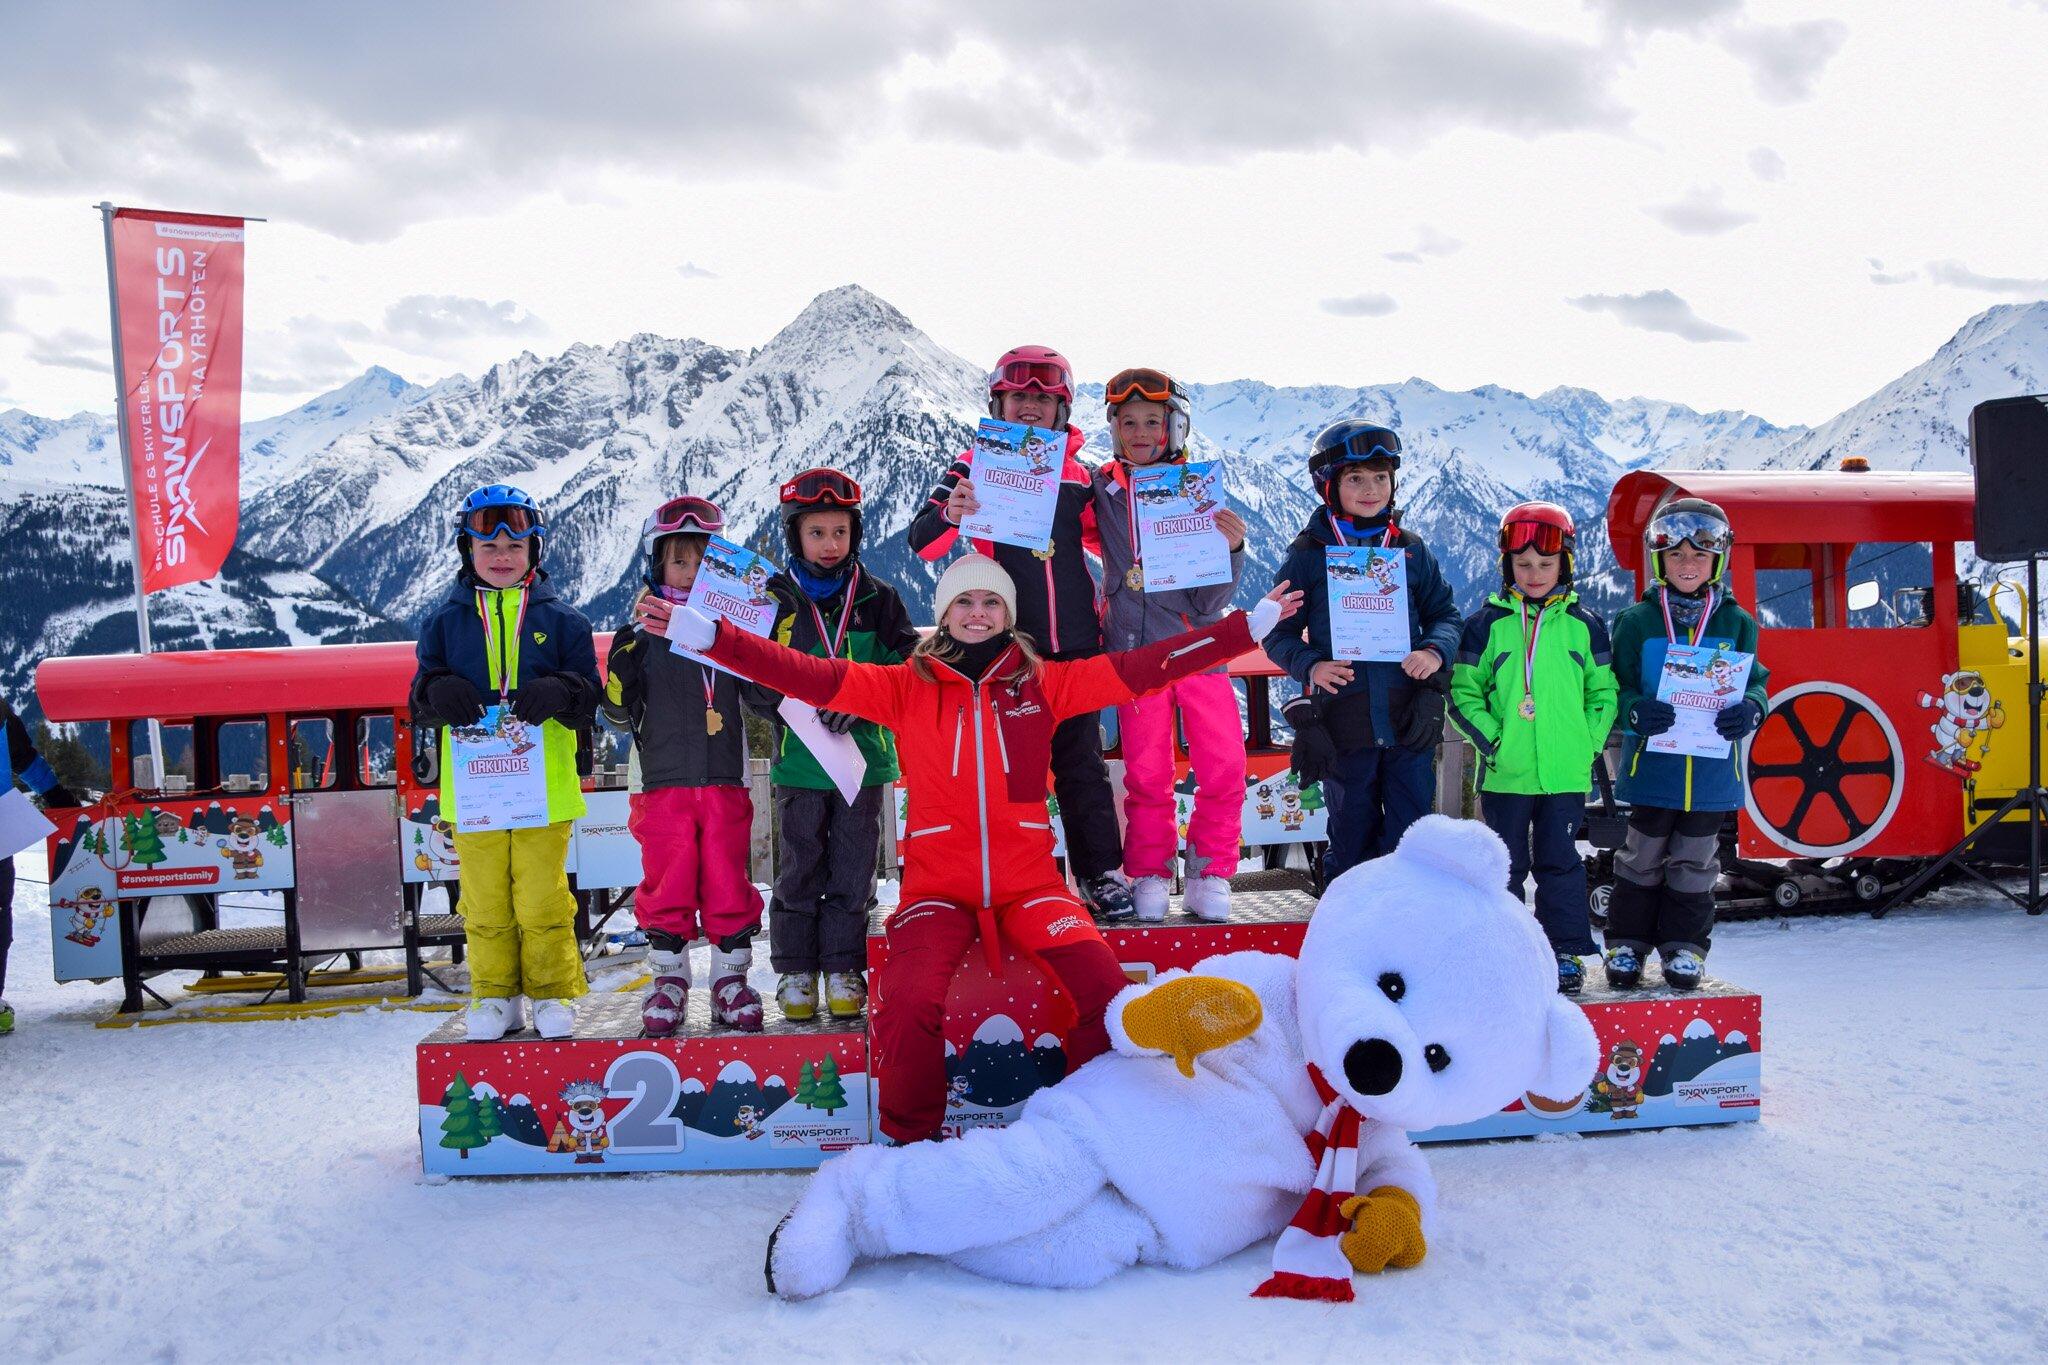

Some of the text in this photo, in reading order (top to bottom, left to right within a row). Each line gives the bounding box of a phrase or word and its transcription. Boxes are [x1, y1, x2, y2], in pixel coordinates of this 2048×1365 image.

[190, 250, 207, 401] MAYRHOFEN
[156, 246, 187, 567] SNOWSPORTS
[147, 465, 156, 478] &
[985, 469, 1043, 493] URKUNDE
[1154, 516, 1212, 536] URKUNDE
[704, 591, 760, 625] URKUNDE
[1342, 595, 1395, 611] URKUNDE
[1670, 692, 1727, 710] URKUNDE
[468, 758, 530, 775] URKUNDE
[581, 825, 628, 834] SNOWSPOR
[121, 870, 214, 884] #snowsportsfamily
[1046, 915, 1077, 931] SNOW
[1678, 1085, 1748, 1097] SNOWSPORT
[605, 1051, 684, 1155] 2
[945, 1112, 1004, 1122] WSPORTS
[773, 1128, 851, 1138] SNOWSPORT
